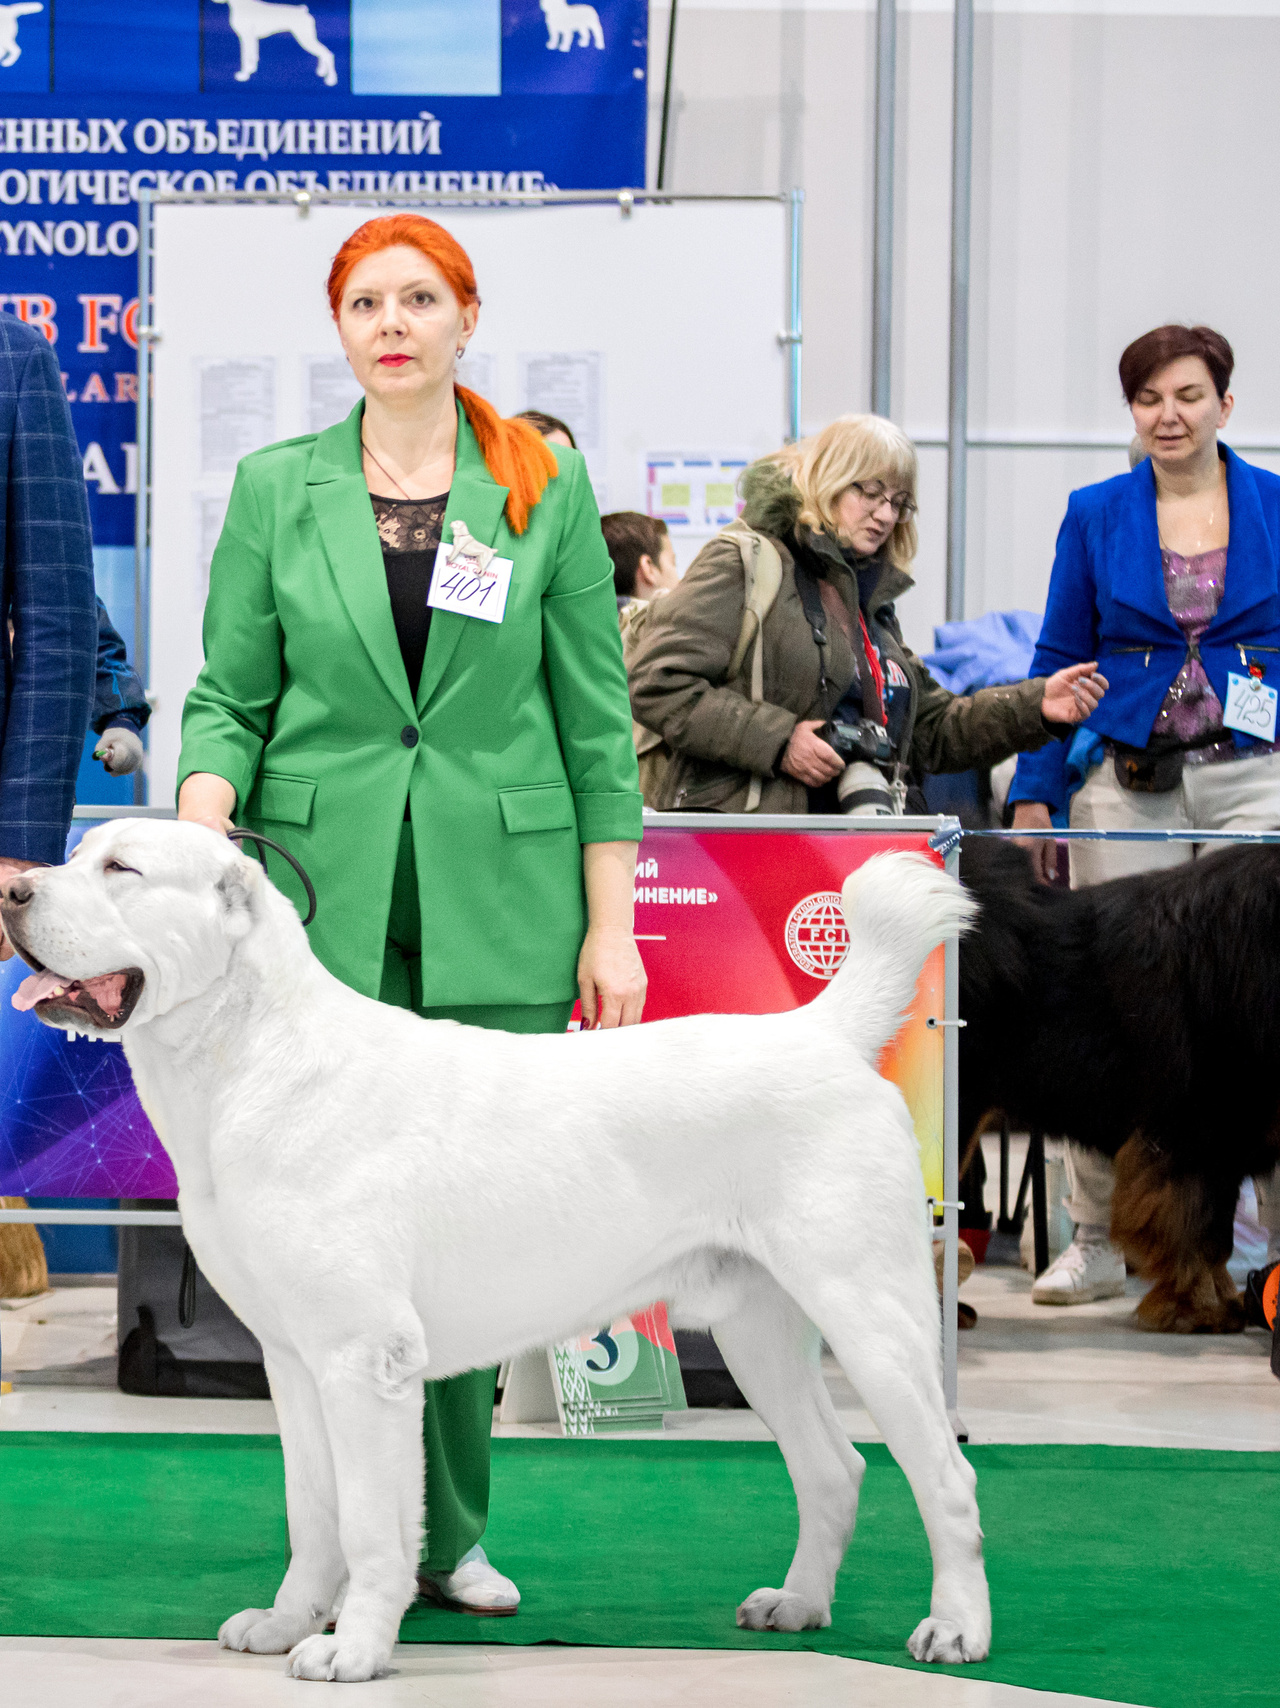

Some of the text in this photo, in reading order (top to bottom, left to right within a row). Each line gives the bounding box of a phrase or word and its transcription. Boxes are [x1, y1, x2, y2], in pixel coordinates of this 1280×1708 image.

[133, 110, 442, 161] ОБЪЕДИНЕНИЙ
[472, 568, 499, 579] CNIN
[440, 572, 496, 606] 401
[1234, 689, 1273, 727] 425
[633, 886, 719, 905] ИНЕНИЕ»
[793, 895, 843, 922] CYNOLOGIQ
[810, 928, 846, 943] FCI
